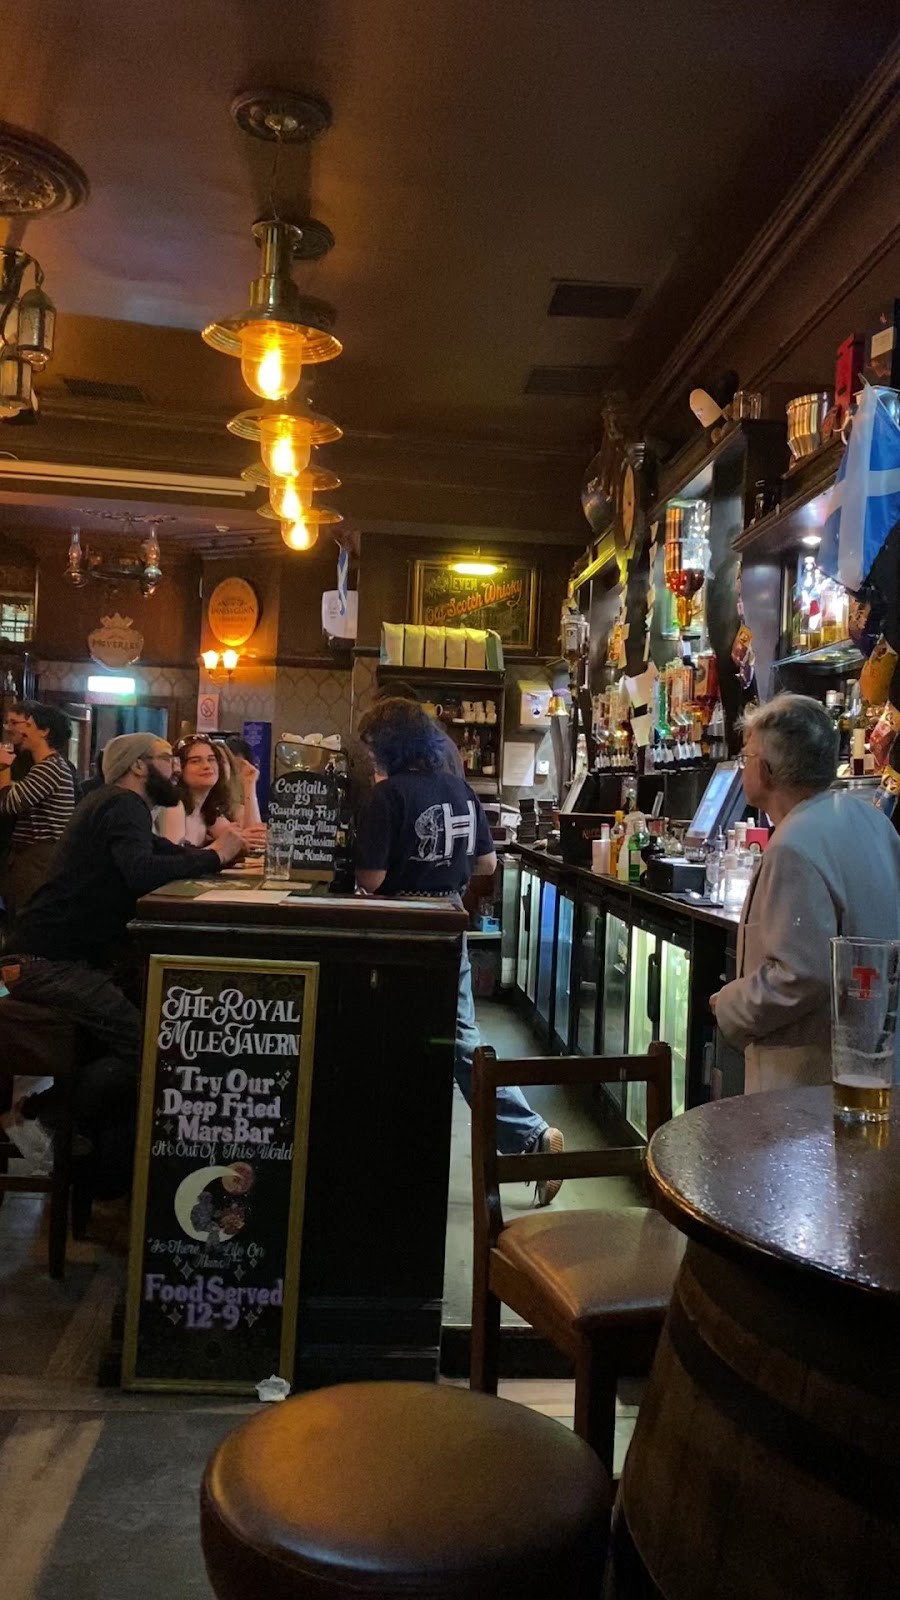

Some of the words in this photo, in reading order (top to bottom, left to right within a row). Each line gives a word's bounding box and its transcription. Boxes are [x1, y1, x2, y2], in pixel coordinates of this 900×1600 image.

[447, 592, 482, 617] Scotch
[482, 579, 522, 607] Whisky
[275, 778, 328, 795] Cocktails
[294, 794, 311, 805] £9
[315, 804, 337, 821] Fizz
[286, 818, 315, 835] Bloody
[315, 820, 338, 838] Mary
[852, 966, 879, 1000] T
[176, 1066, 223, 1097] Try
[225, 1068, 275, 1095] Our
[163, 1088, 217, 1122] Deep
[221, 1092, 281, 1119] Fried
[177, 1115, 233, 1142] Mars
[233, 1118, 275, 1144] Bar
[175, 1141, 199, 1157] Out
[199, 1141, 216, 1165] Of
[222, 1142, 256, 1160] This
[256, 1142, 293, 1161] World
[247, 1242, 265, 1258] On
[144, 1274, 204, 1303] Food
[205, 1275, 284, 1307] Served
[184, 1302, 241, 1330] 12-9
